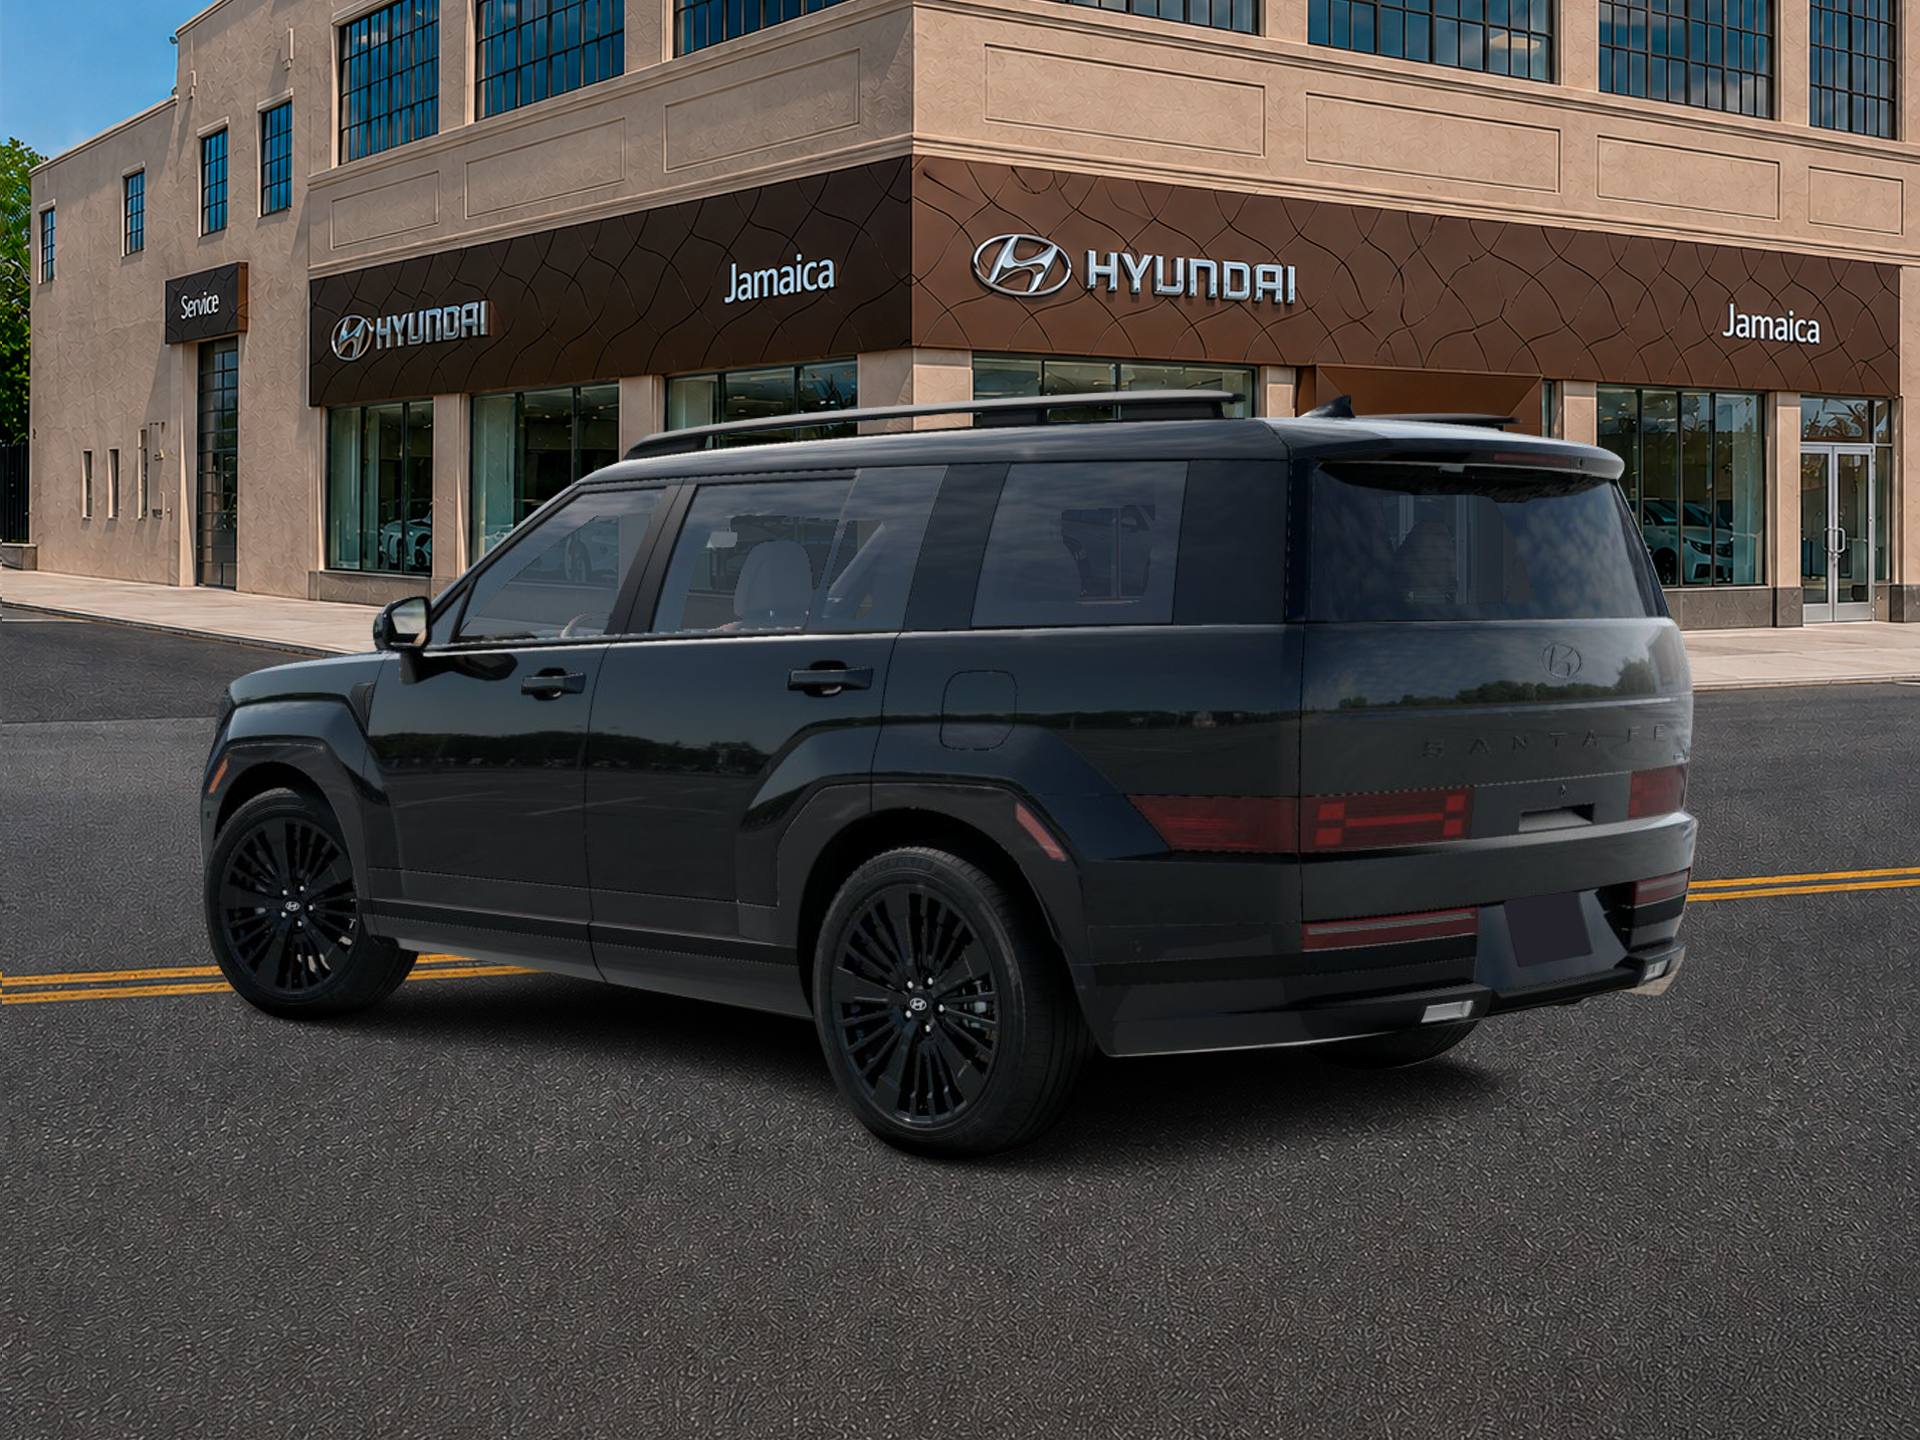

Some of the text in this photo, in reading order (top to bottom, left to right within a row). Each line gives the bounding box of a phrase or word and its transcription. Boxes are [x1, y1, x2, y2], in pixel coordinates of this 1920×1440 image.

[724, 253, 835, 304] Jamaica
[1086, 249, 1297, 305] HYUNDAI
[180, 291, 220, 320] Service
[375, 300, 490, 350] HYUNDAI
[1722, 303, 1820, 344] Jamaica
[1421, 723, 1667, 758] SANTA FE
